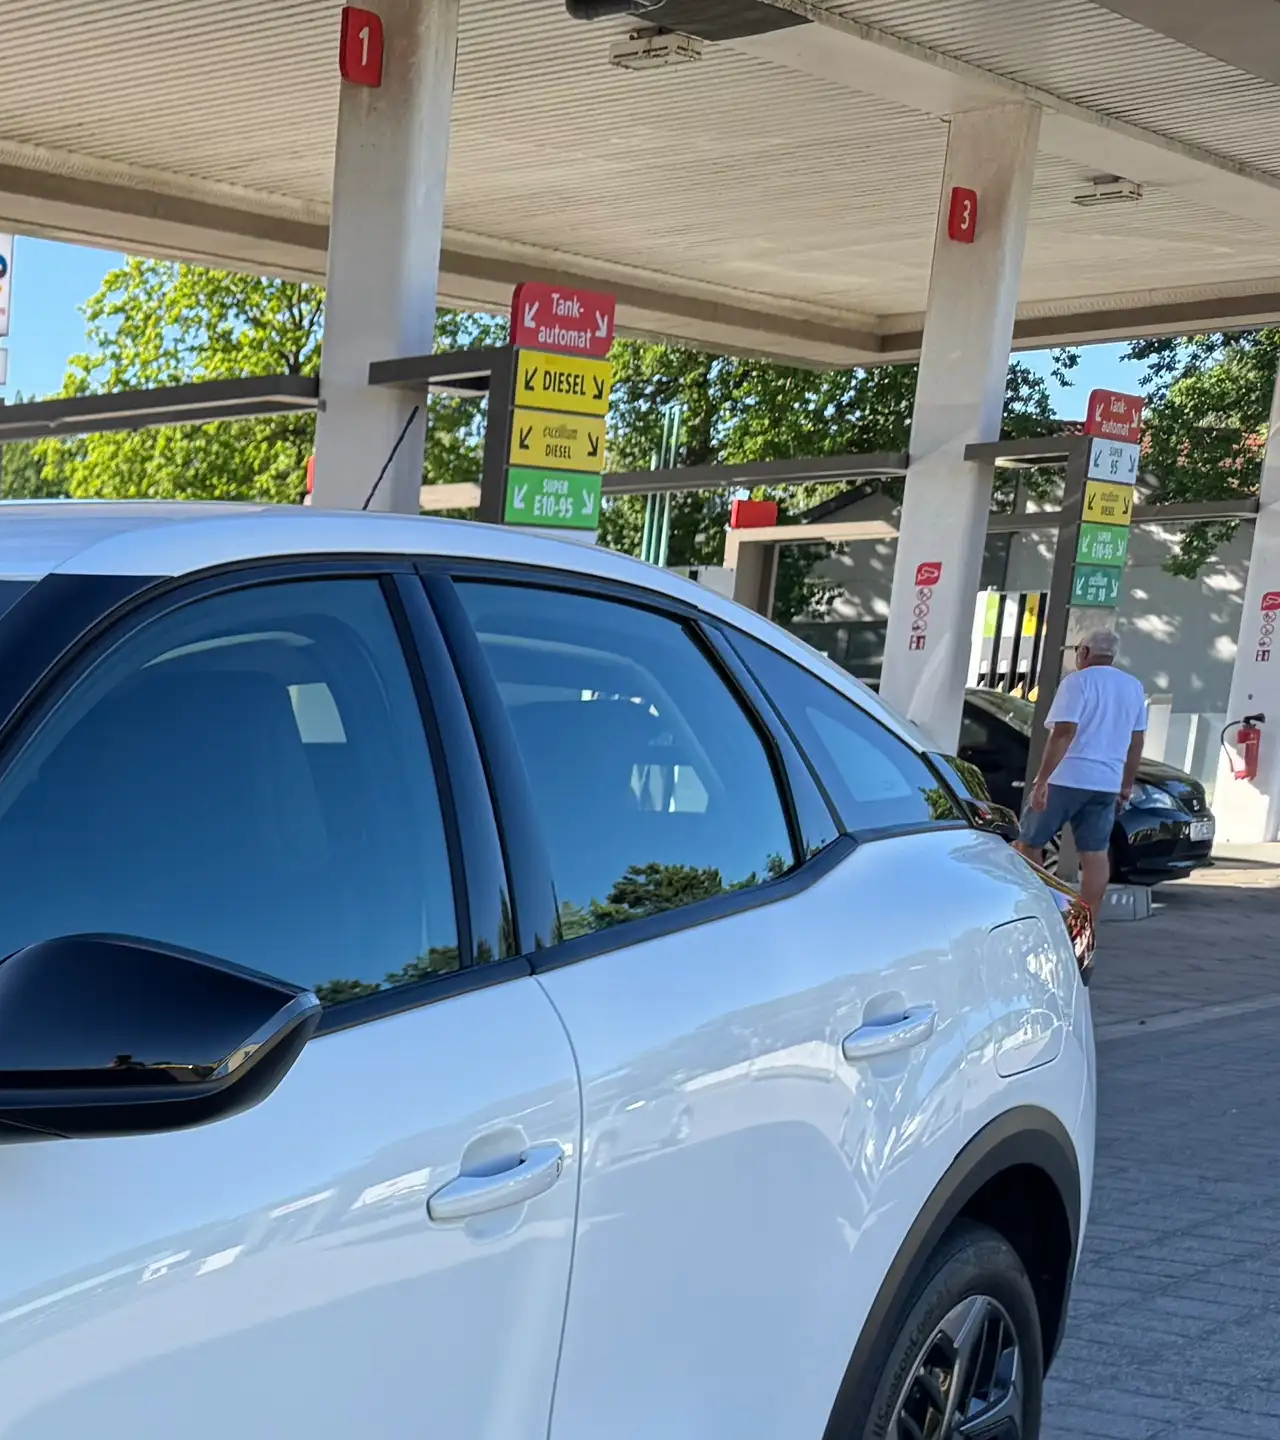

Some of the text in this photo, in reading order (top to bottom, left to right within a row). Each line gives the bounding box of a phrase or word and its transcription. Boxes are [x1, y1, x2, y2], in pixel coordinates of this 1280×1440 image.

[358, 25, 370, 67] 1
[960, 199, 971, 230] 3
[550, 292, 585, 319] Tank-
[538, 324, 593, 349] automat
[542, 370, 587, 397] DIESEL
[544, 444, 571, 459] DIESEL
[543, 478, 569, 494] SUPER
[533, 494, 575, 519] E10-95
